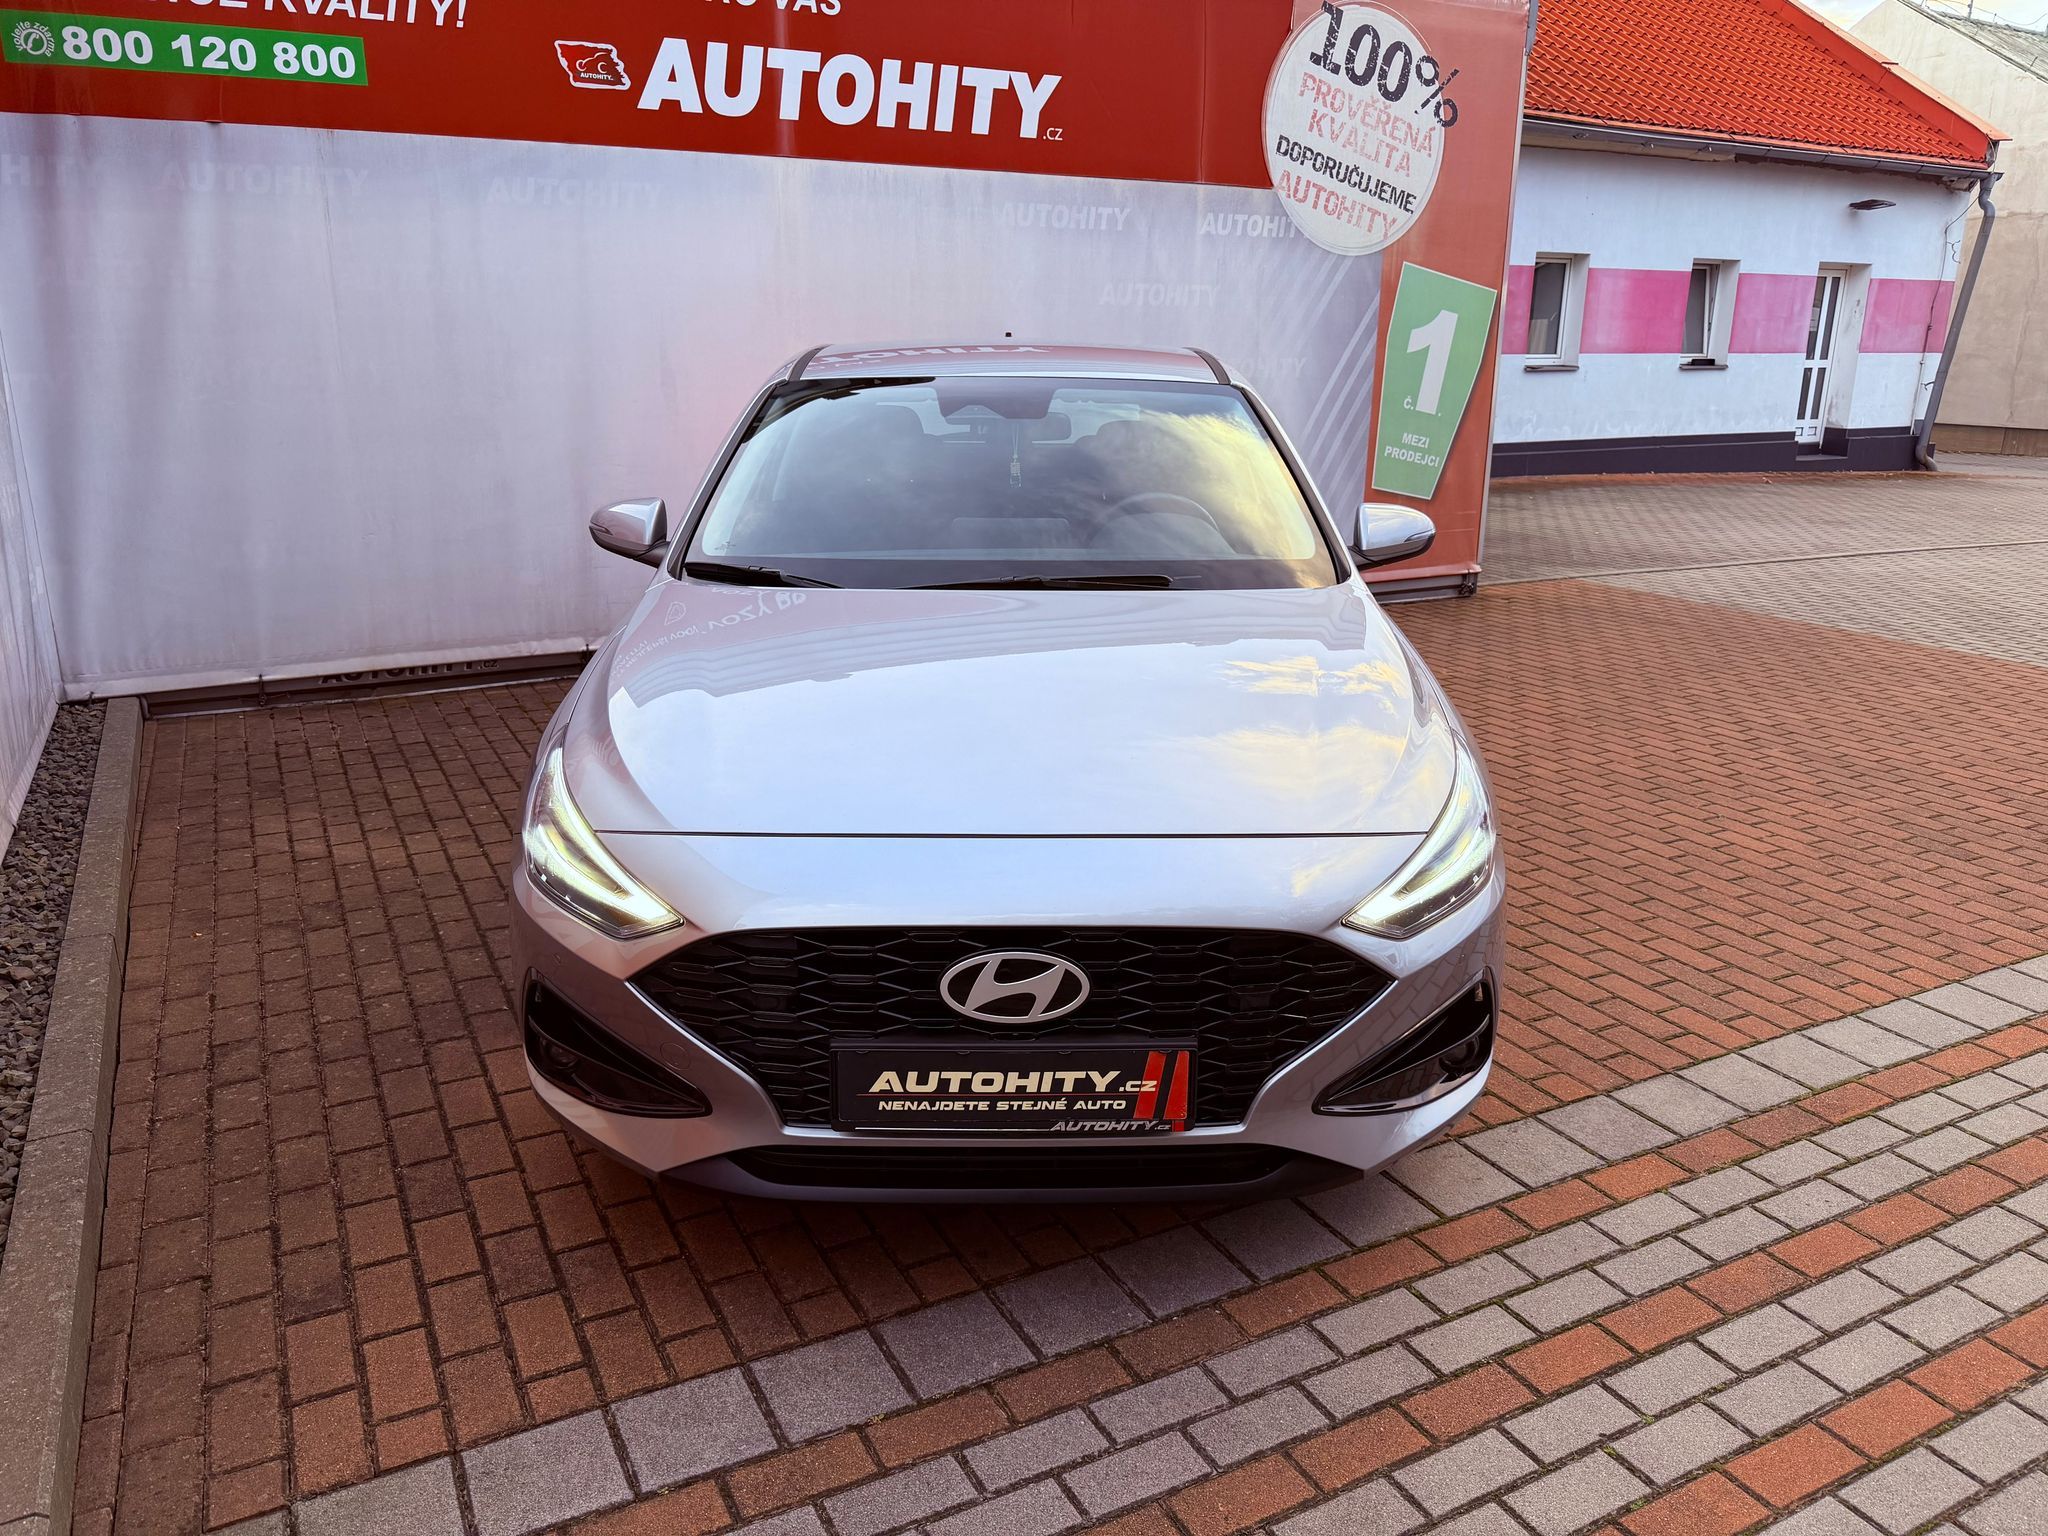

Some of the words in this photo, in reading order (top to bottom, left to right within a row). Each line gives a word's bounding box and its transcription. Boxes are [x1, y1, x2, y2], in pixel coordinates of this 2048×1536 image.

[61, 25, 153, 65] 800
[171, 34, 257, 72] 120
[273, 41, 356, 79] 800
[1309, 0, 1460, 128] 100%
[1299, 72, 1436, 158] PROVĚŘENÁ
[1307, 109, 1411, 177] KVALITA
[1276, 134, 1417, 214] DOPORUČUJEME
[1276, 170, 1398, 241] AUTOHITY
[1384, 446, 1440, 468] PRODEJCI
[1401, 432, 1429, 449] MEZI
[878, 1100, 989, 1111] NENAJDETE
[996, 1097, 1067, 1111] STEJNÉ
[1073, 1100, 1127, 1110] AUTO
